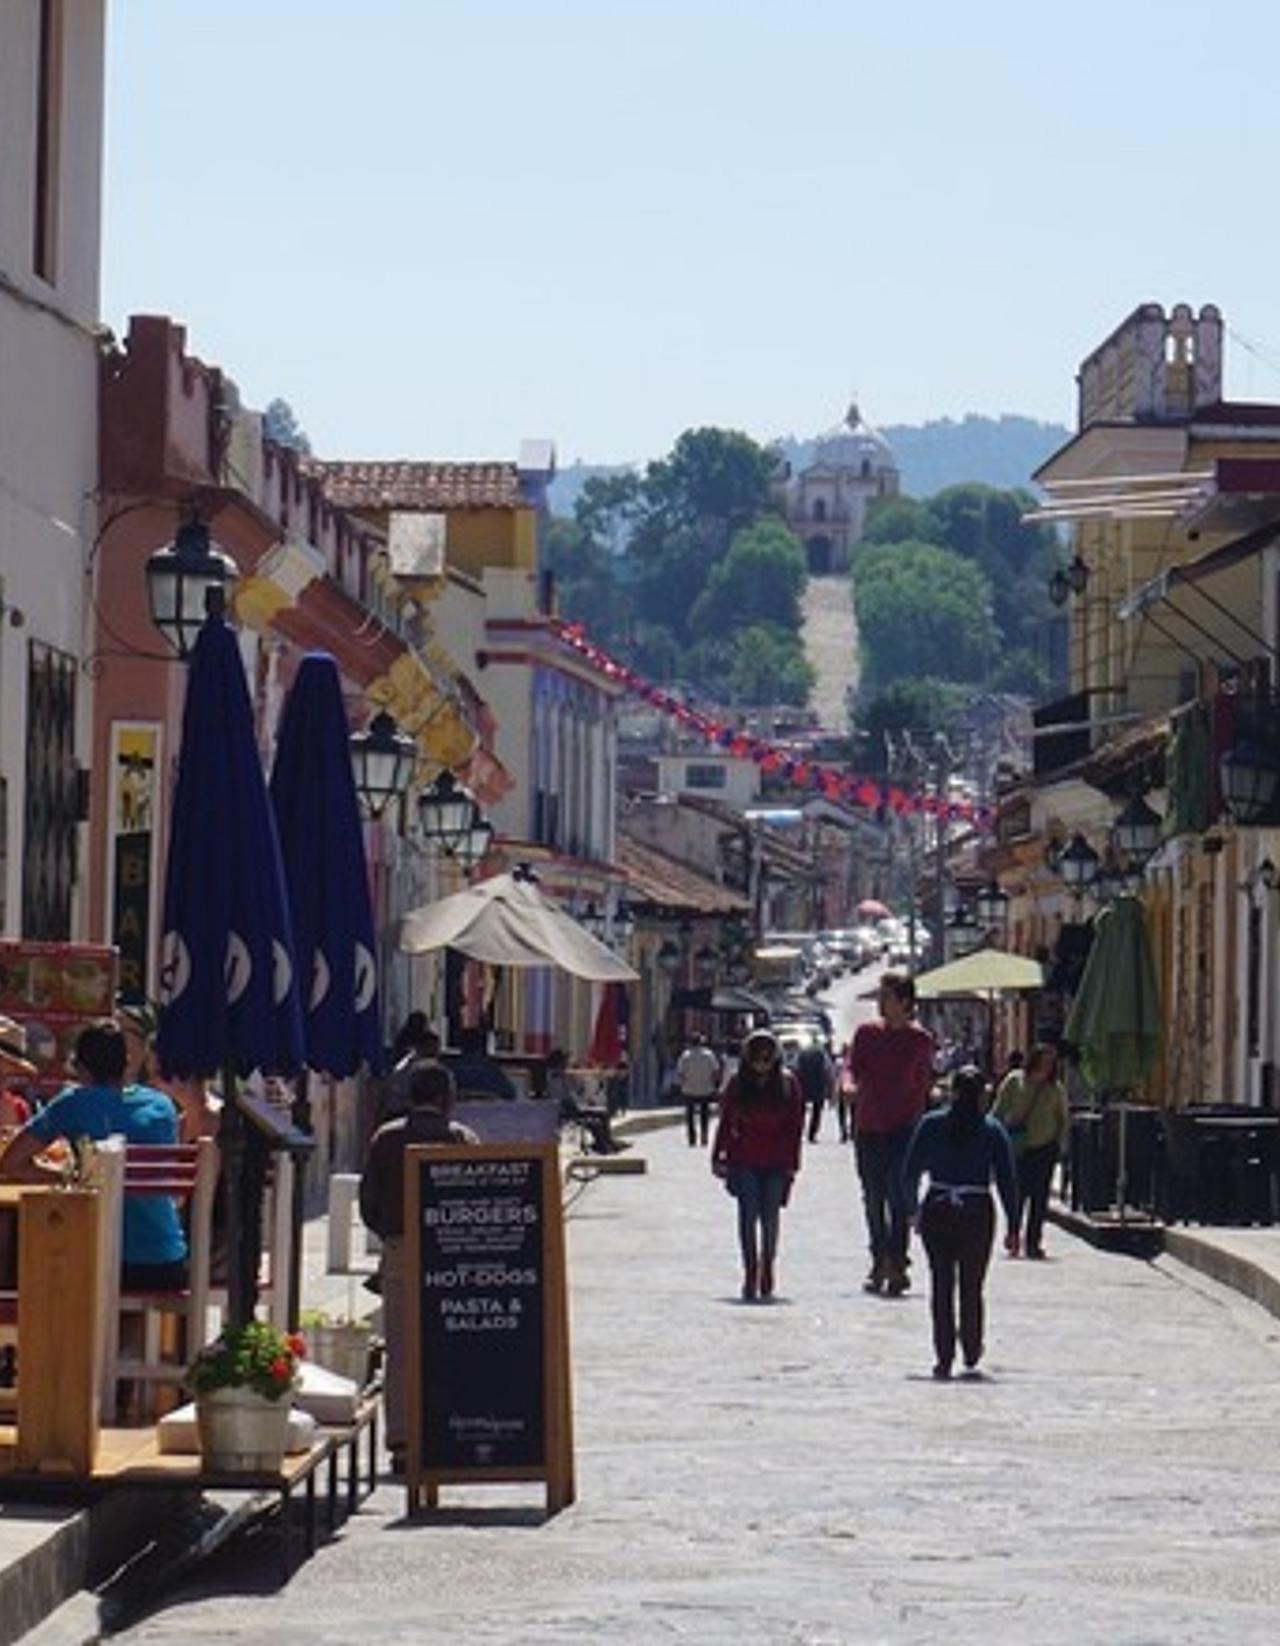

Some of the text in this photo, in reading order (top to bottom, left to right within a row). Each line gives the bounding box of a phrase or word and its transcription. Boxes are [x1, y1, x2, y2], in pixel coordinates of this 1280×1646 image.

[122, 855, 146, 988] BAR
[429, 1162, 530, 1179] BREAKFAST
[425, 1204, 538, 1225] BURGERS
[440, 1297, 522, 1315] PASTA &
[444, 1316, 519, 1332] SALADS
